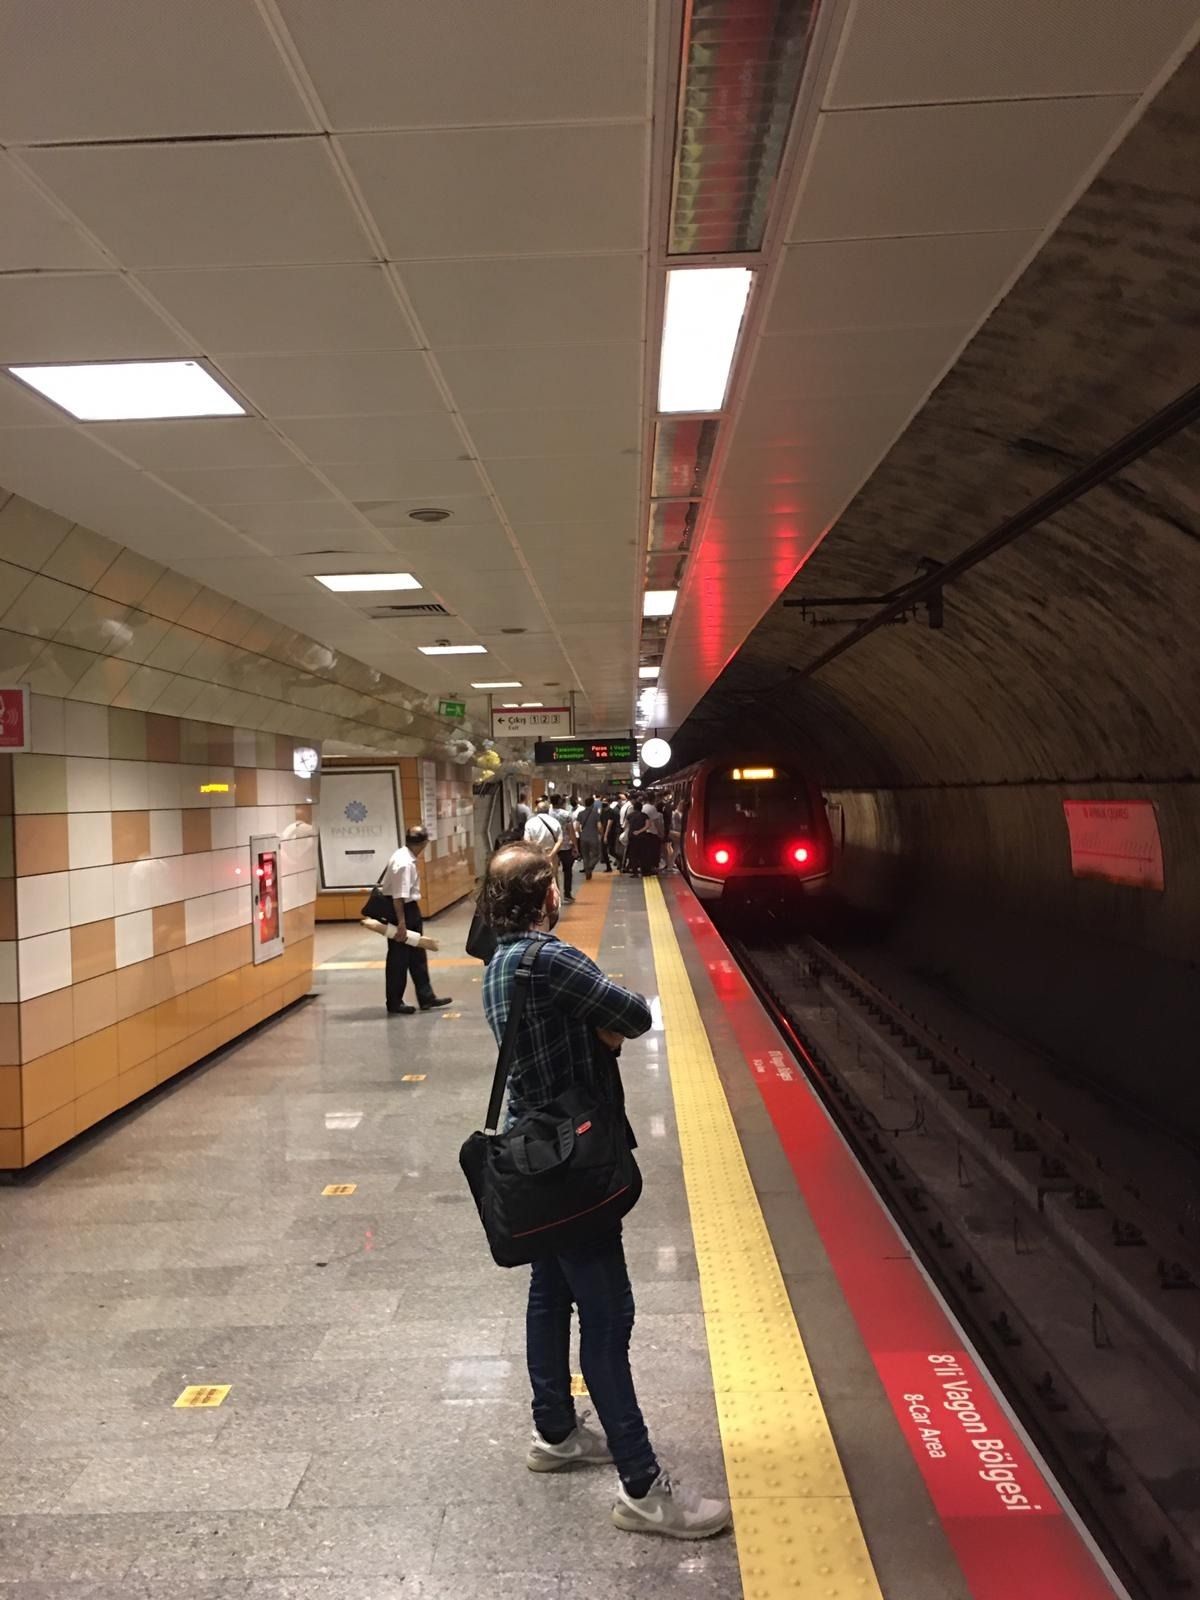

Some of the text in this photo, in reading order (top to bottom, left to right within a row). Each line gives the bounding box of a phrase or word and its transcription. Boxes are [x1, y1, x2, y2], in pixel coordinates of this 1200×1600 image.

[904, 1393, 946, 1458] 8-Car Area
[928, 1354, 1041, 1510] 8'li Vagon Bölgesi
